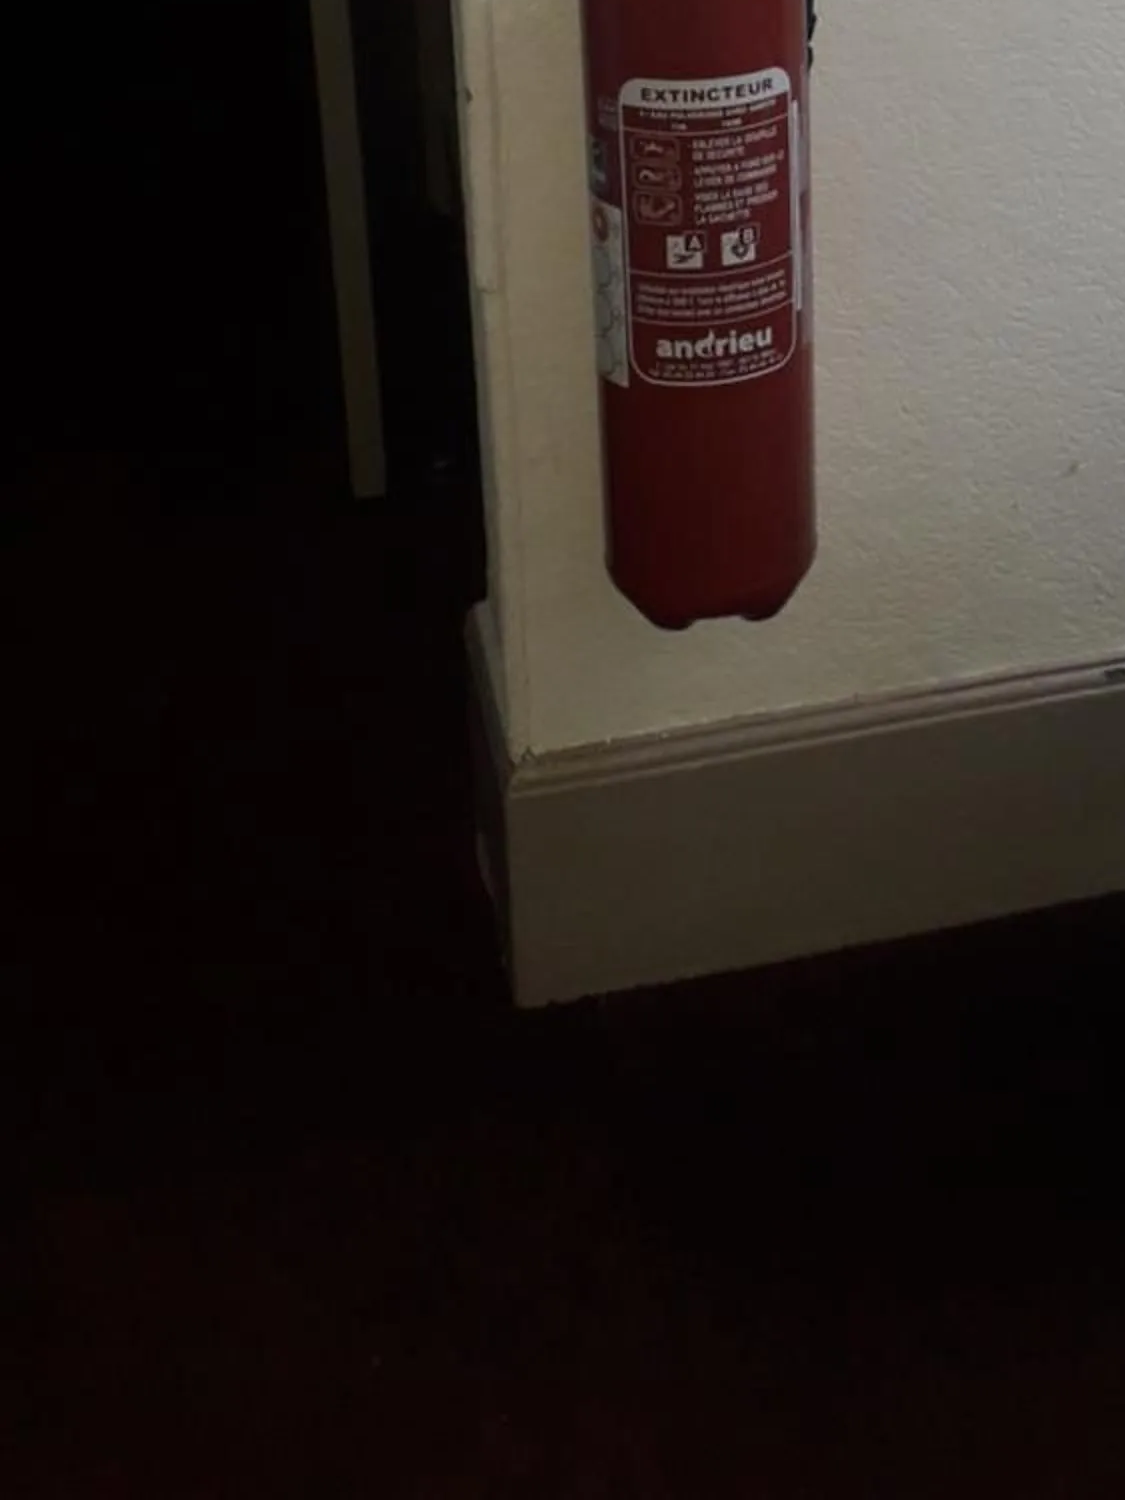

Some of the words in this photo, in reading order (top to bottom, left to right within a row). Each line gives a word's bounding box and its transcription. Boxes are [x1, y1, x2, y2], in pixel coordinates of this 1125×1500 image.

[639, 78, 774, 103] EXTINCTEUR
[689, 235, 702, 249] A
[656, 326, 773, 359] andrieu
